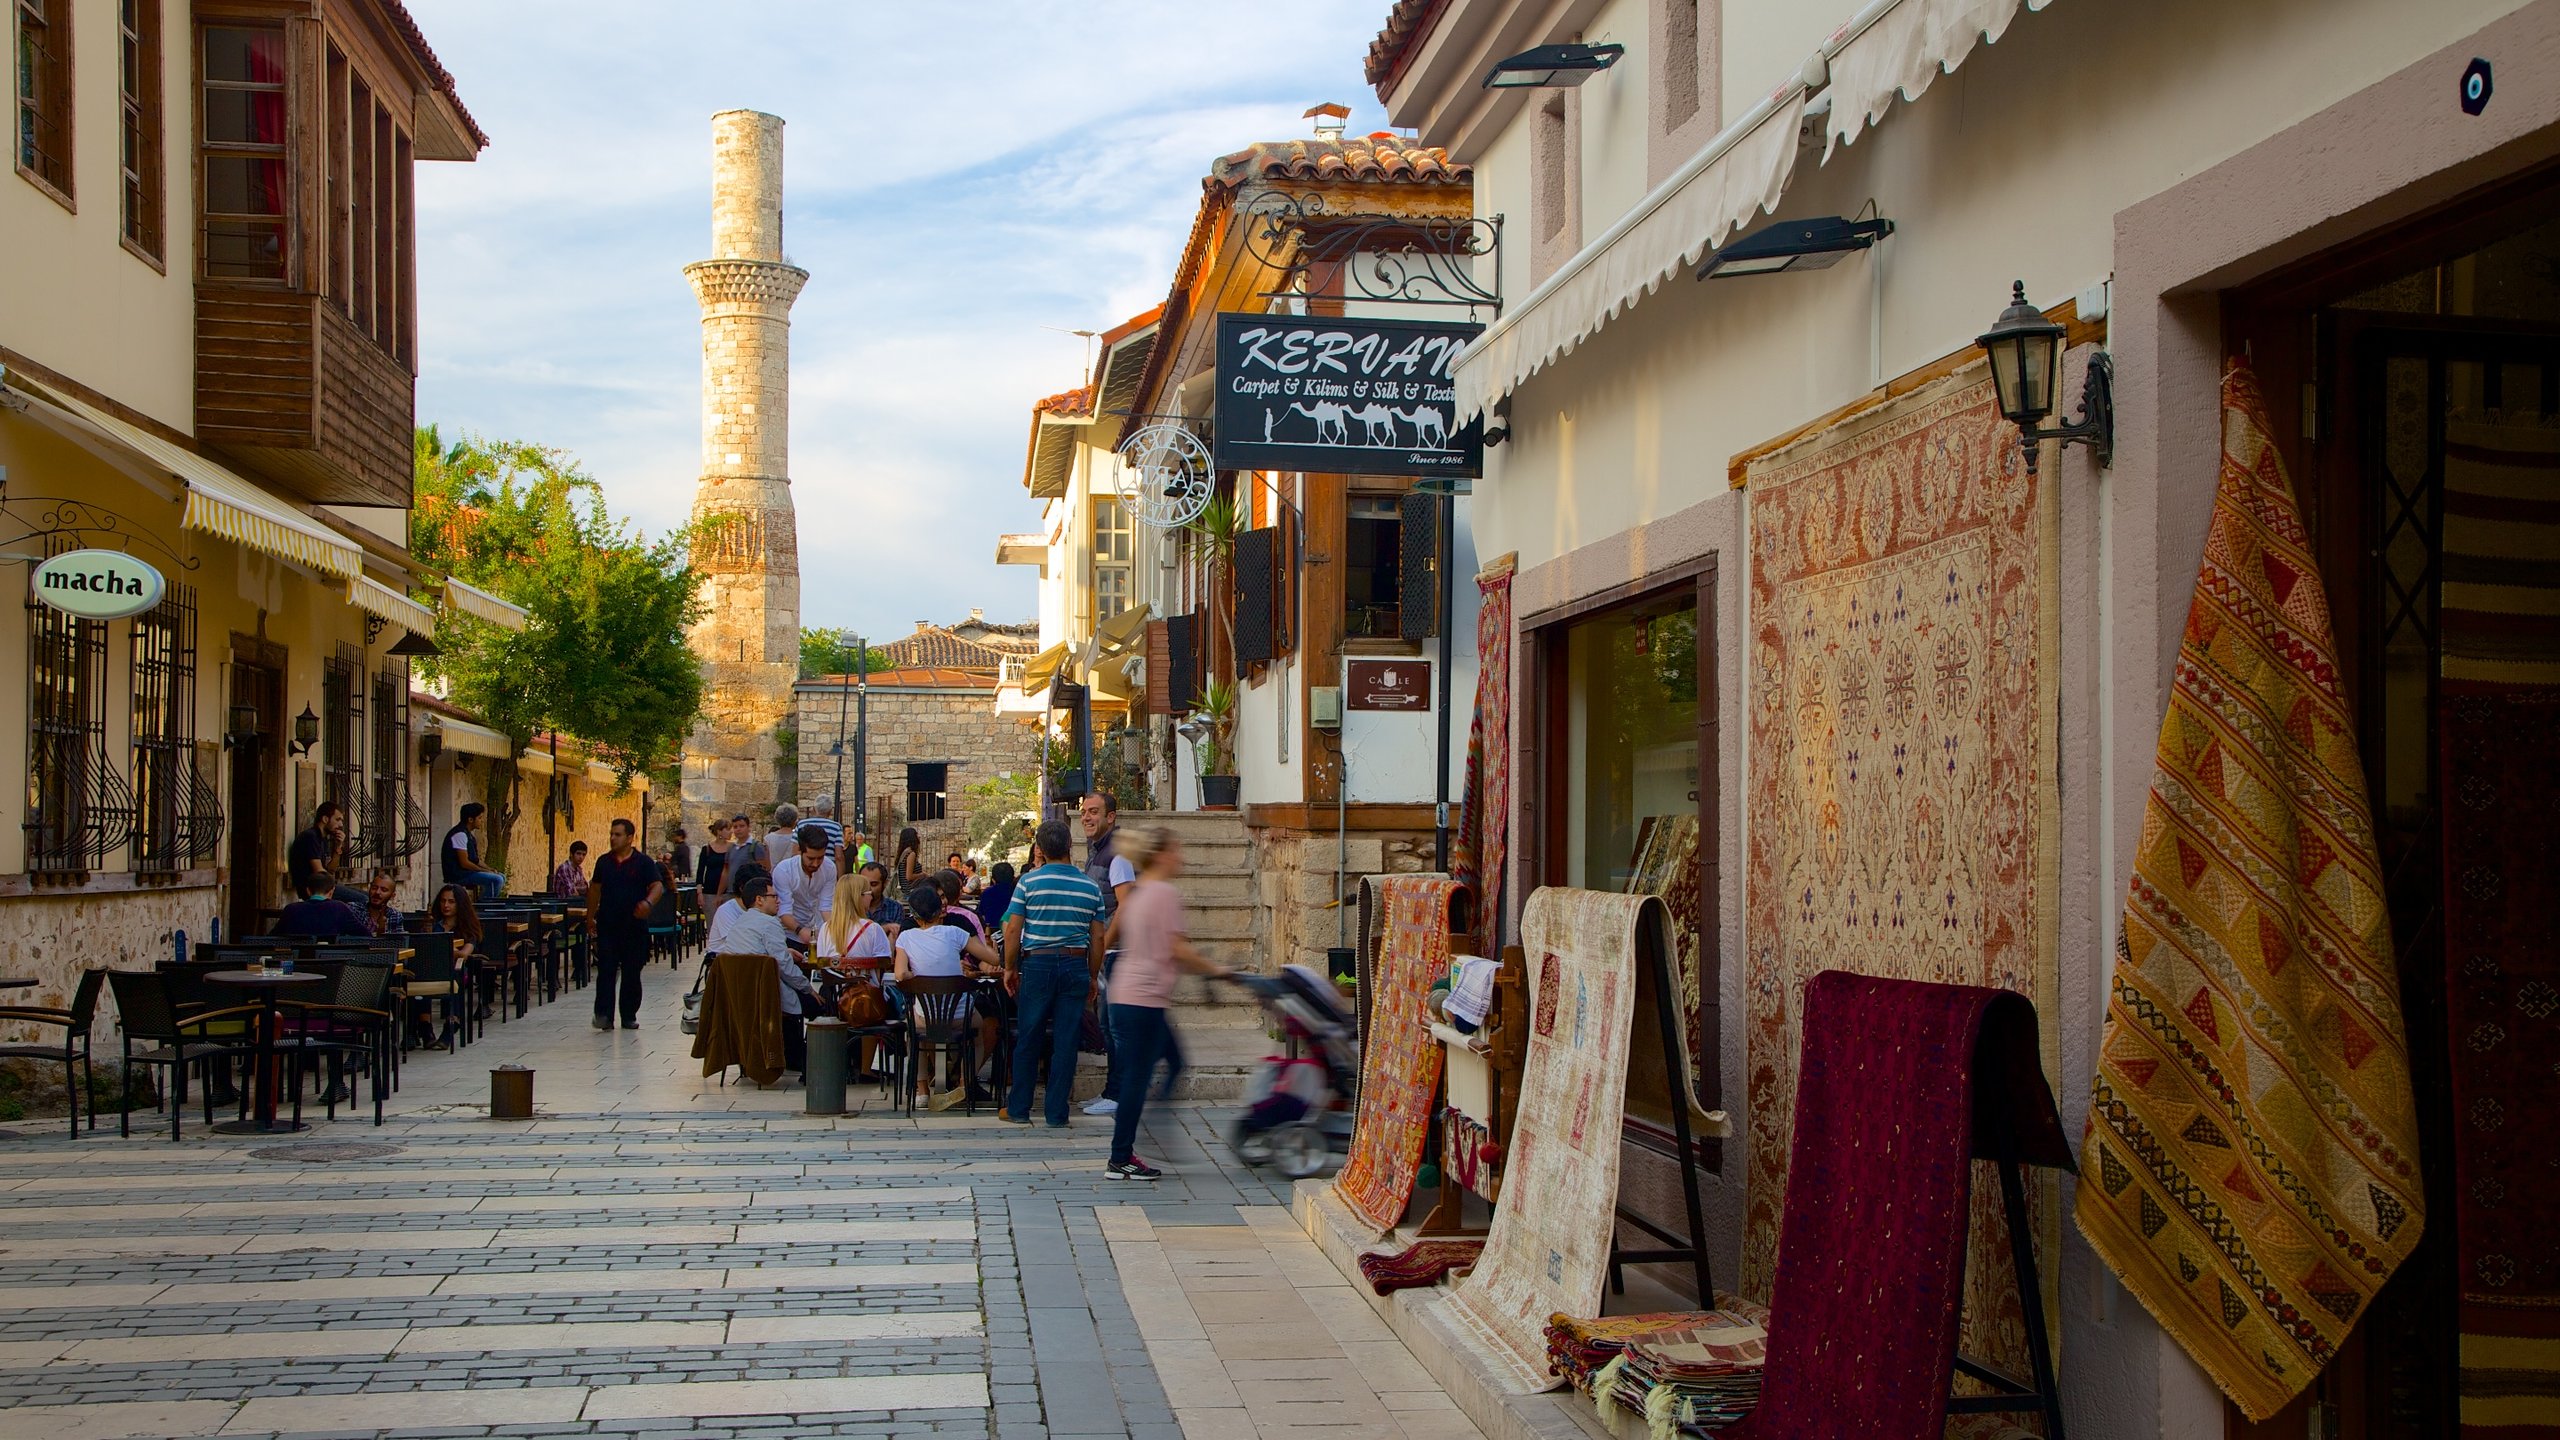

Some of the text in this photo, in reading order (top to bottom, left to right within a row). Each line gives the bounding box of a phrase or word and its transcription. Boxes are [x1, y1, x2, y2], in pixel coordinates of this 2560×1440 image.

[1239, 328, 1465, 379] KERVAN
[1233, 375, 1456, 402] Carpet & Kilims & Silk & Texti
[1407, 453, 1465, 464] Since 1986
[44, 569, 143, 597] macha
